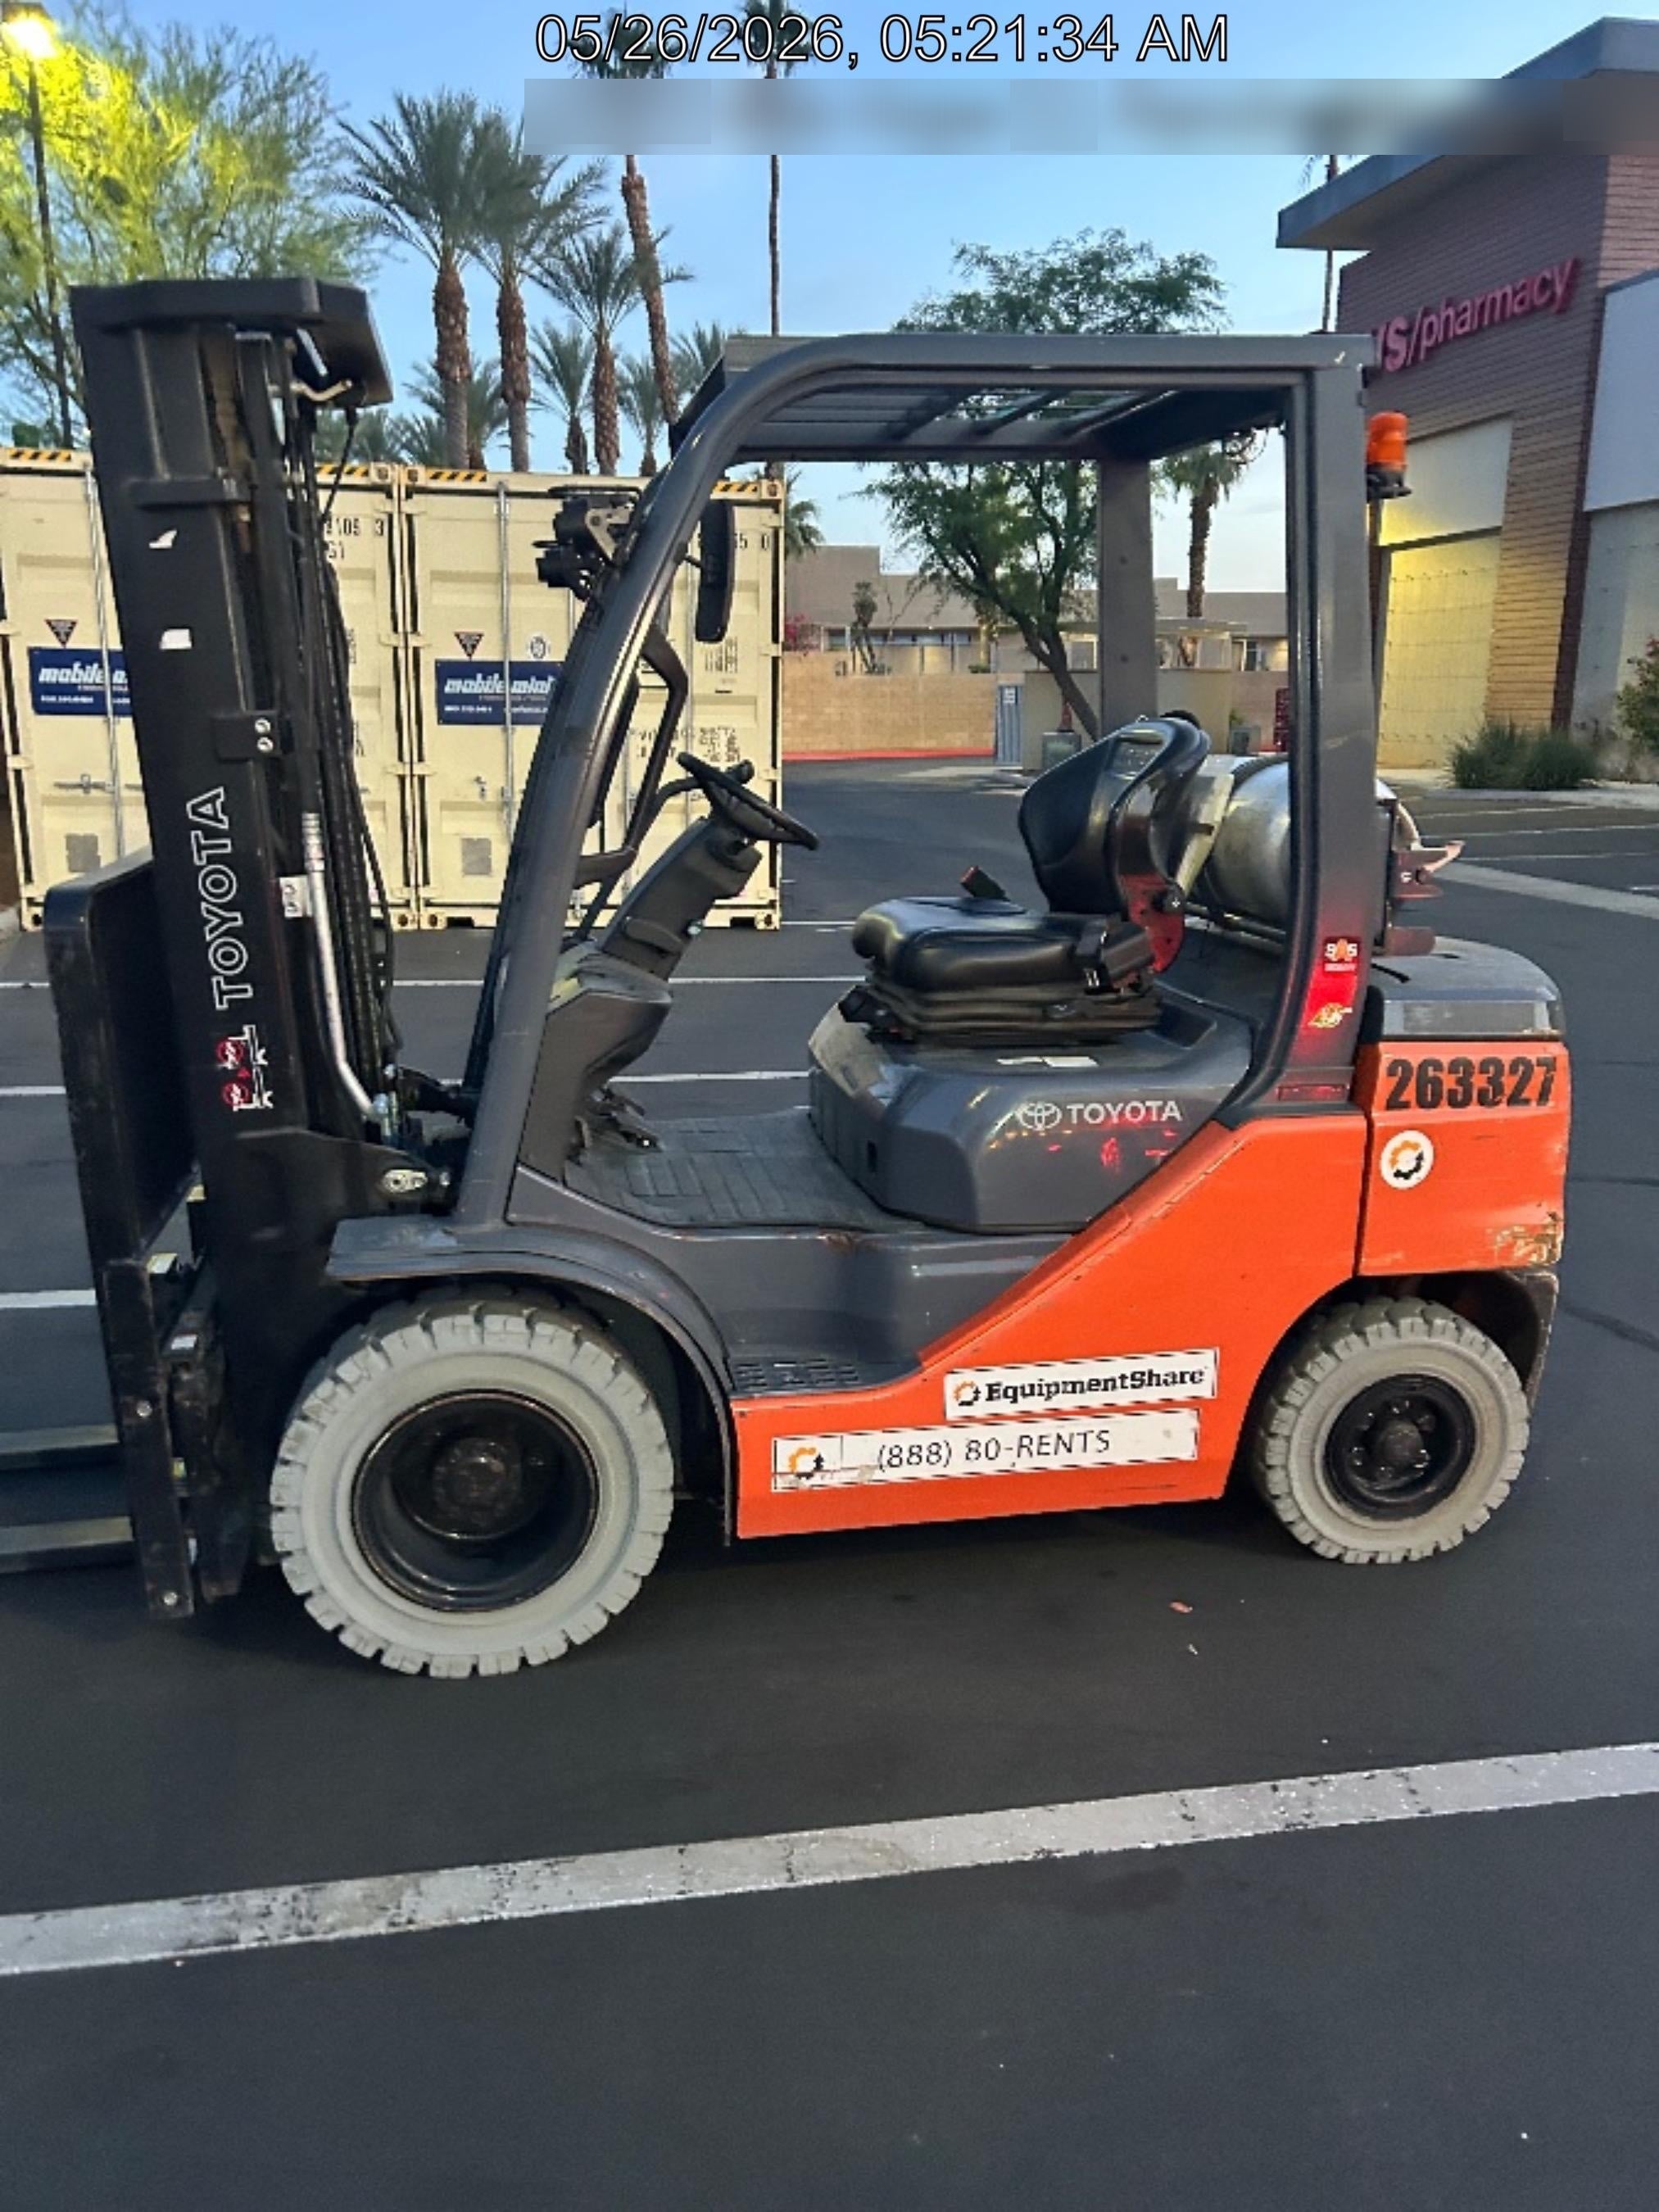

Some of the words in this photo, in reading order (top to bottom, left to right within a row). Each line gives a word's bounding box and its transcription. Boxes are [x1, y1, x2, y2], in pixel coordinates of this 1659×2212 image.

[186, 786, 253, 1010] TOYOTA
[1386, 1057, 1557, 1109] 263327
[1066, 1099, 1183, 1125] TOYOTA
[985, 1367, 1204, 1403] EquipmentShare
[877, 1440, 954, 1471] (888)
[964, 1429, 1111, 1464] 80-RENTS
